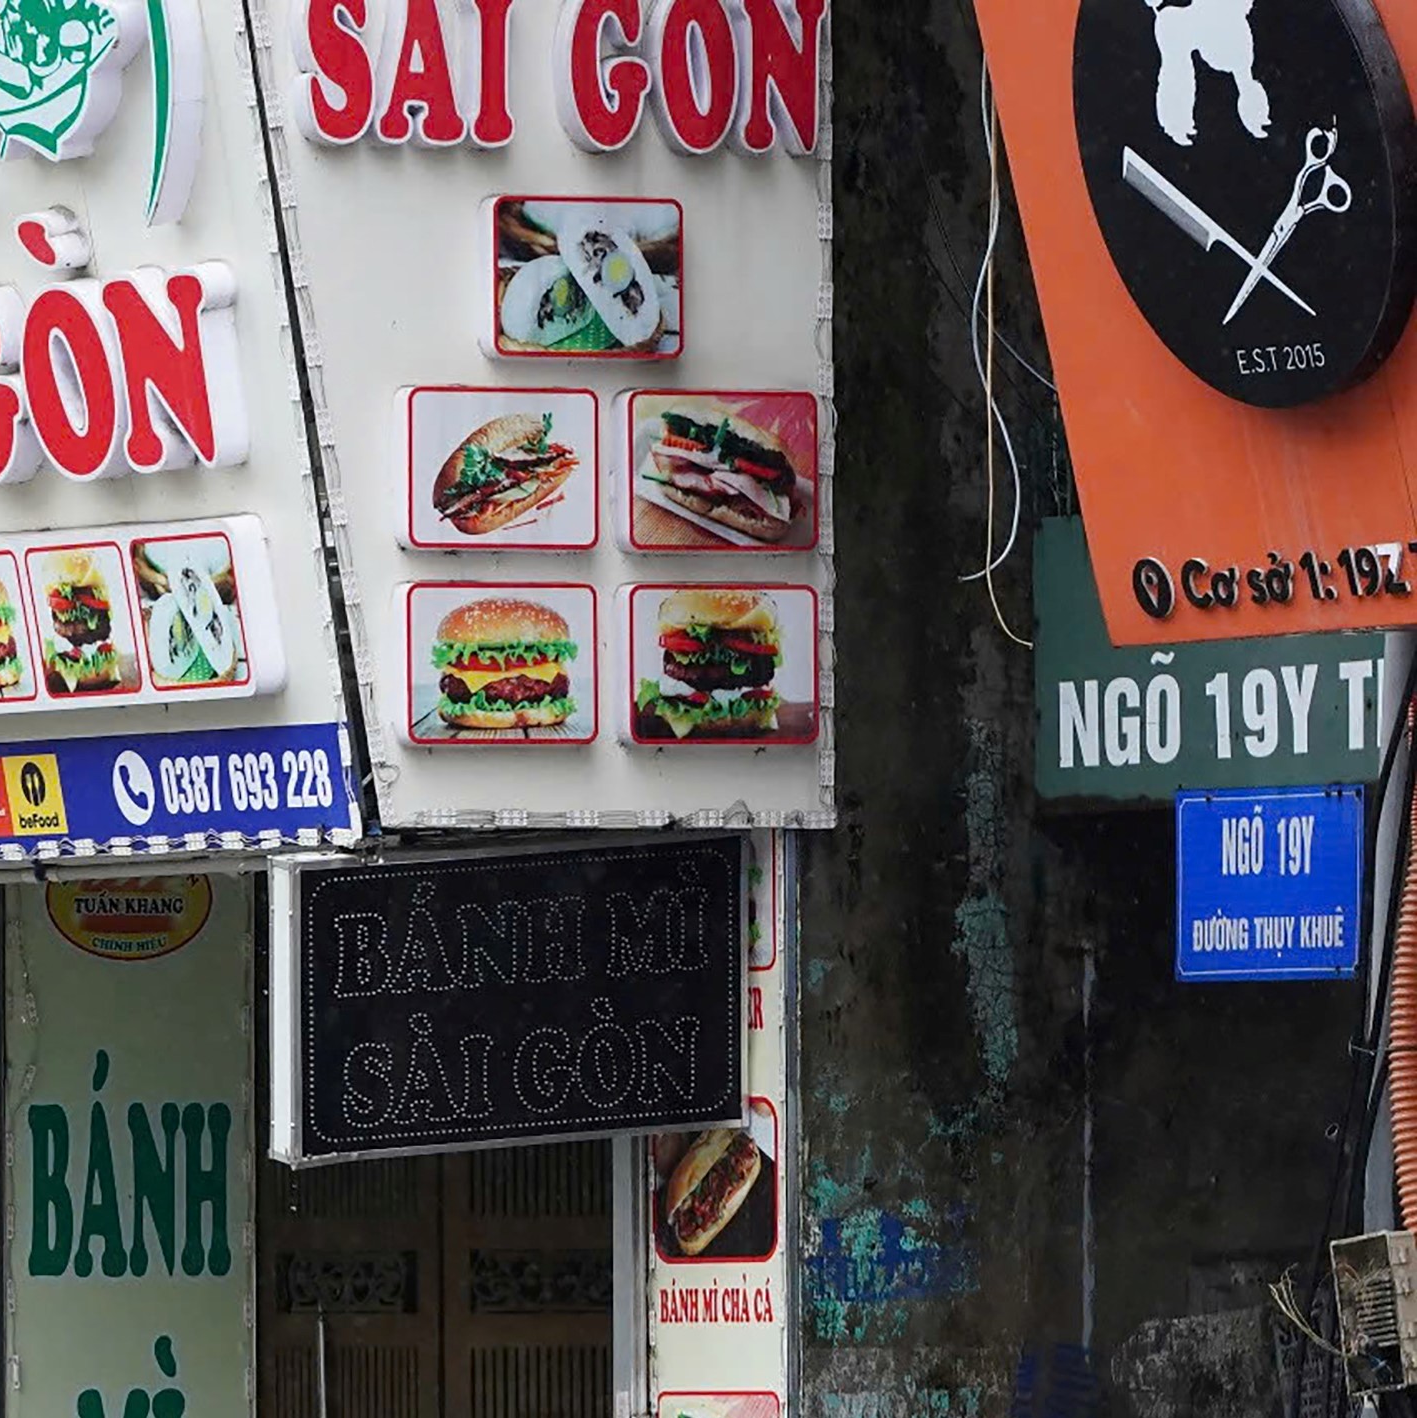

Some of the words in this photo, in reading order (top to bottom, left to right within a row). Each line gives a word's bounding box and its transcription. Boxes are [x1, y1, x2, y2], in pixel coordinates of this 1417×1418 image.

[1283, 344, 1326, 371] 2015
[1181, 558, 1239, 608] Cơ
[1247, 551, 1296, 604] sở
[1299, 551, 1338, 600] 1:
[1059, 651, 1180, 768] NGÕ
[1206, 663, 1319, 760] 19Y
[159, 756, 223, 815] 0387
[228, 752, 278, 811] 693
[281, 749, 333, 807] 228
[19, 812, 60, 829] beFood
[1222, 806, 1264, 875] NGÕ
[1277, 815, 1315, 875] 19Y
[74, 891, 119, 914] TUẤN
[125, 898, 184, 914] KHANG
[334, 881, 587, 998] BÁNH
[606, 860, 710, 977] MÌ
[1193, 908, 1249, 952] ĐƯỜNG
[1254, 916, 1295, 957] THỤY
[1300, 905, 1344, 949] KHUÊ
[341, 1012, 495, 1129] SÀI
[513, 997, 701, 1113] GÒN
[28, 1049, 232, 1277] BÁNH
[659, 1280, 700, 1324] BÁNH
[702, 1278, 720, 1323] MÌ
[721, 1273, 750, 1323] CHẢ
[754, 1278, 774, 1323] CÁ
